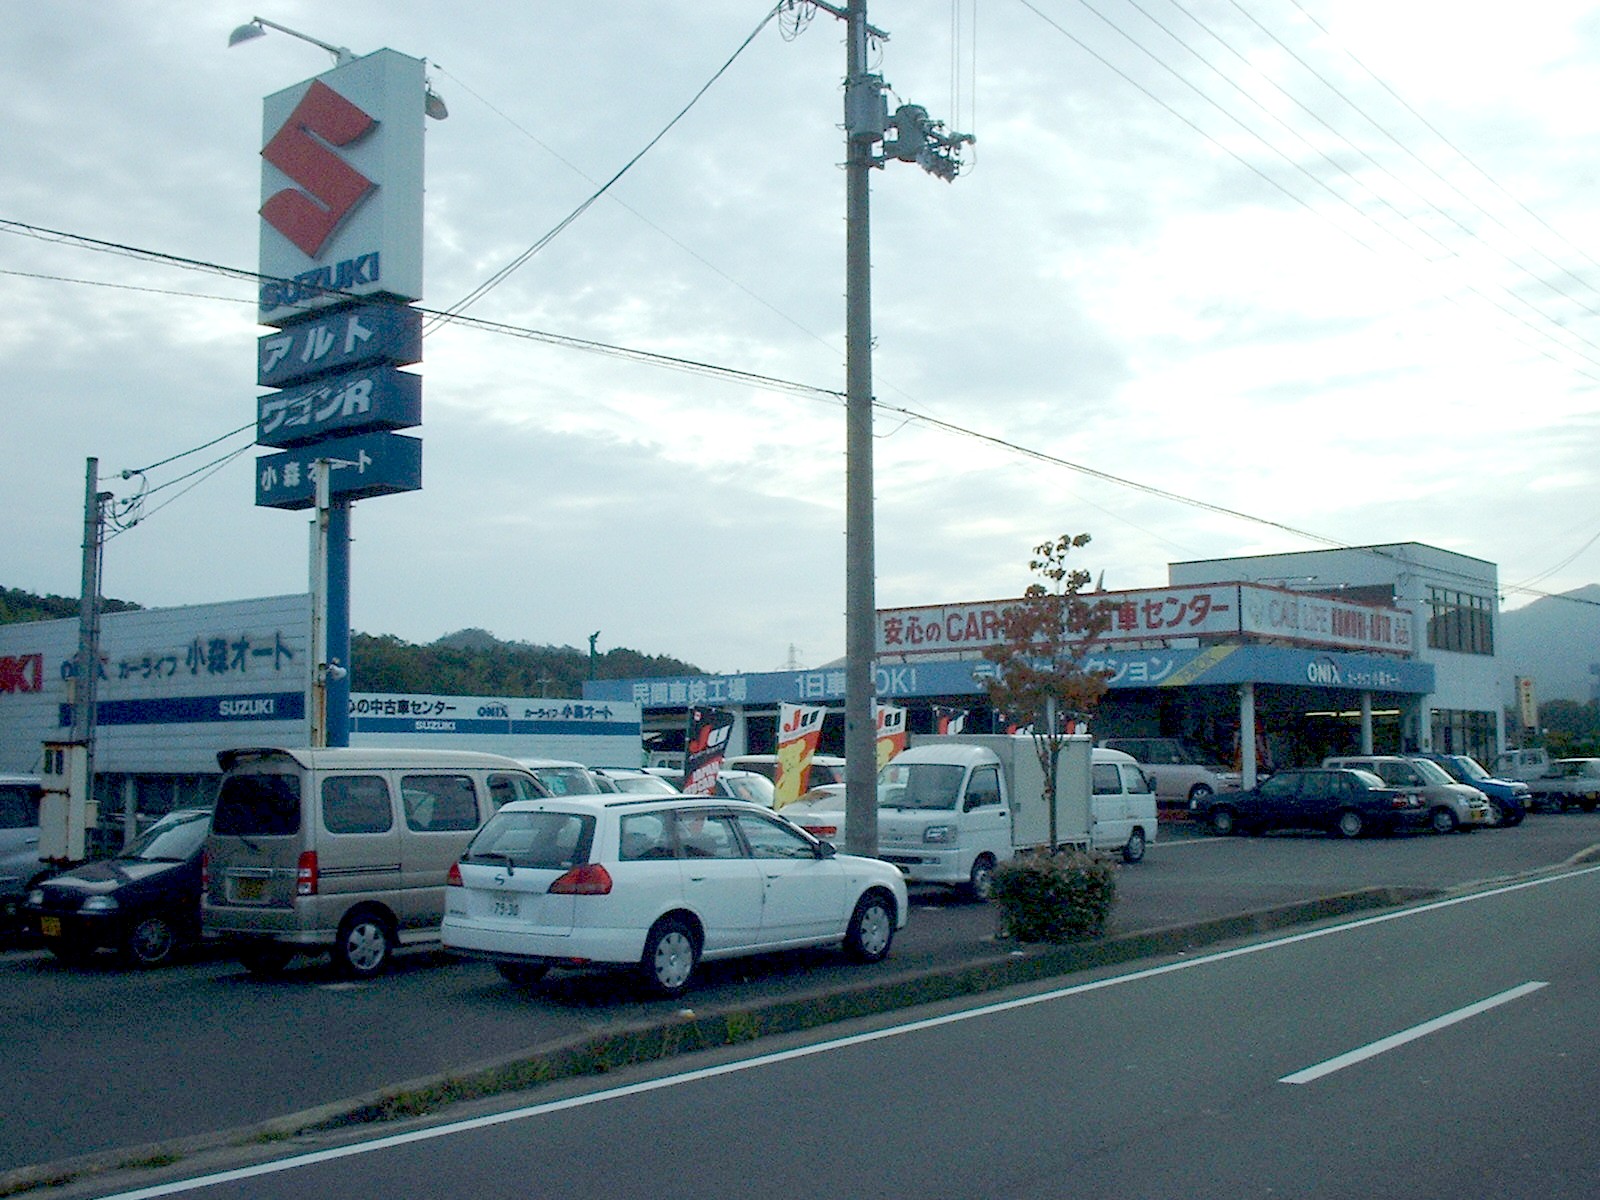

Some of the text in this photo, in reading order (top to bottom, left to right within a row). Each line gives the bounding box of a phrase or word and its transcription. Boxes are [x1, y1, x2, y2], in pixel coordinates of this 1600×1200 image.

[260, 252, 379, 312] SUZUKI
[263, 312, 373, 373] アルト
[262, 378, 373, 434] ワゴンR
[185, 630, 293, 677] 小森オート
[0, 653, 43, 694] KI
[1306, 661, 1341, 685] ONIX
[218, 699, 274, 716] SUZUKI
[632, 677, 748, 704] 民間車検工場
[415, 720, 457, 731] SUZUKI
[477, 704, 509, 718] ONIX
